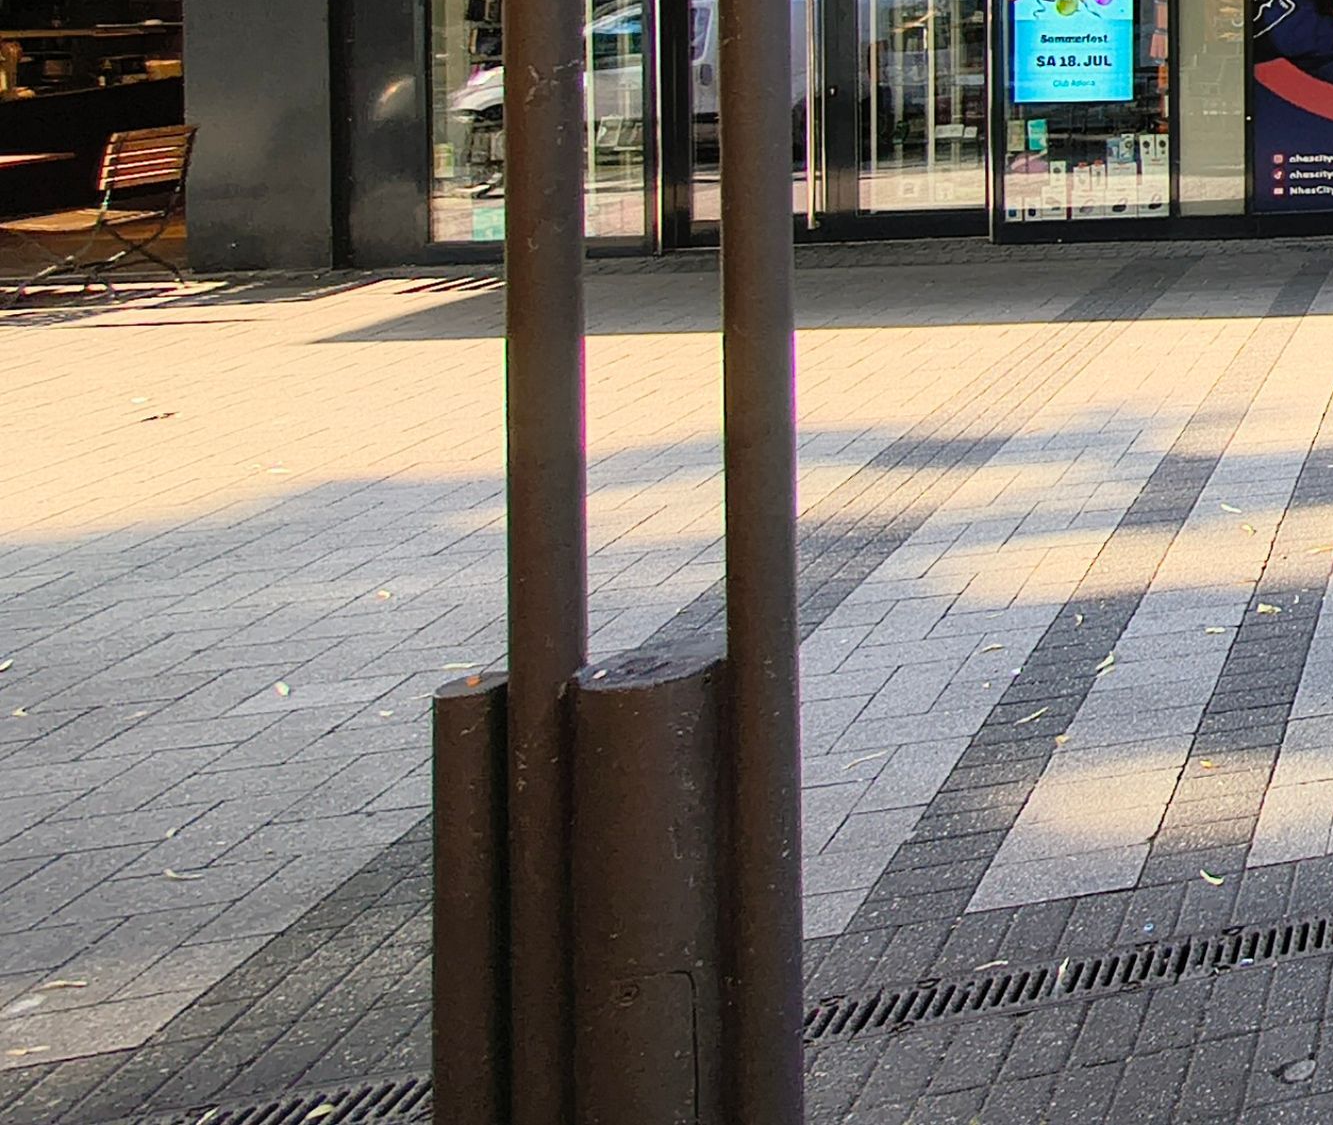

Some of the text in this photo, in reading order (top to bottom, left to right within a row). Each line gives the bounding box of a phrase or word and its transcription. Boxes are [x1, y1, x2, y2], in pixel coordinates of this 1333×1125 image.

[1040, 33, 1109, 44] Sommerfest
[1036, 55, 1112, 67] SA 18. JUL
